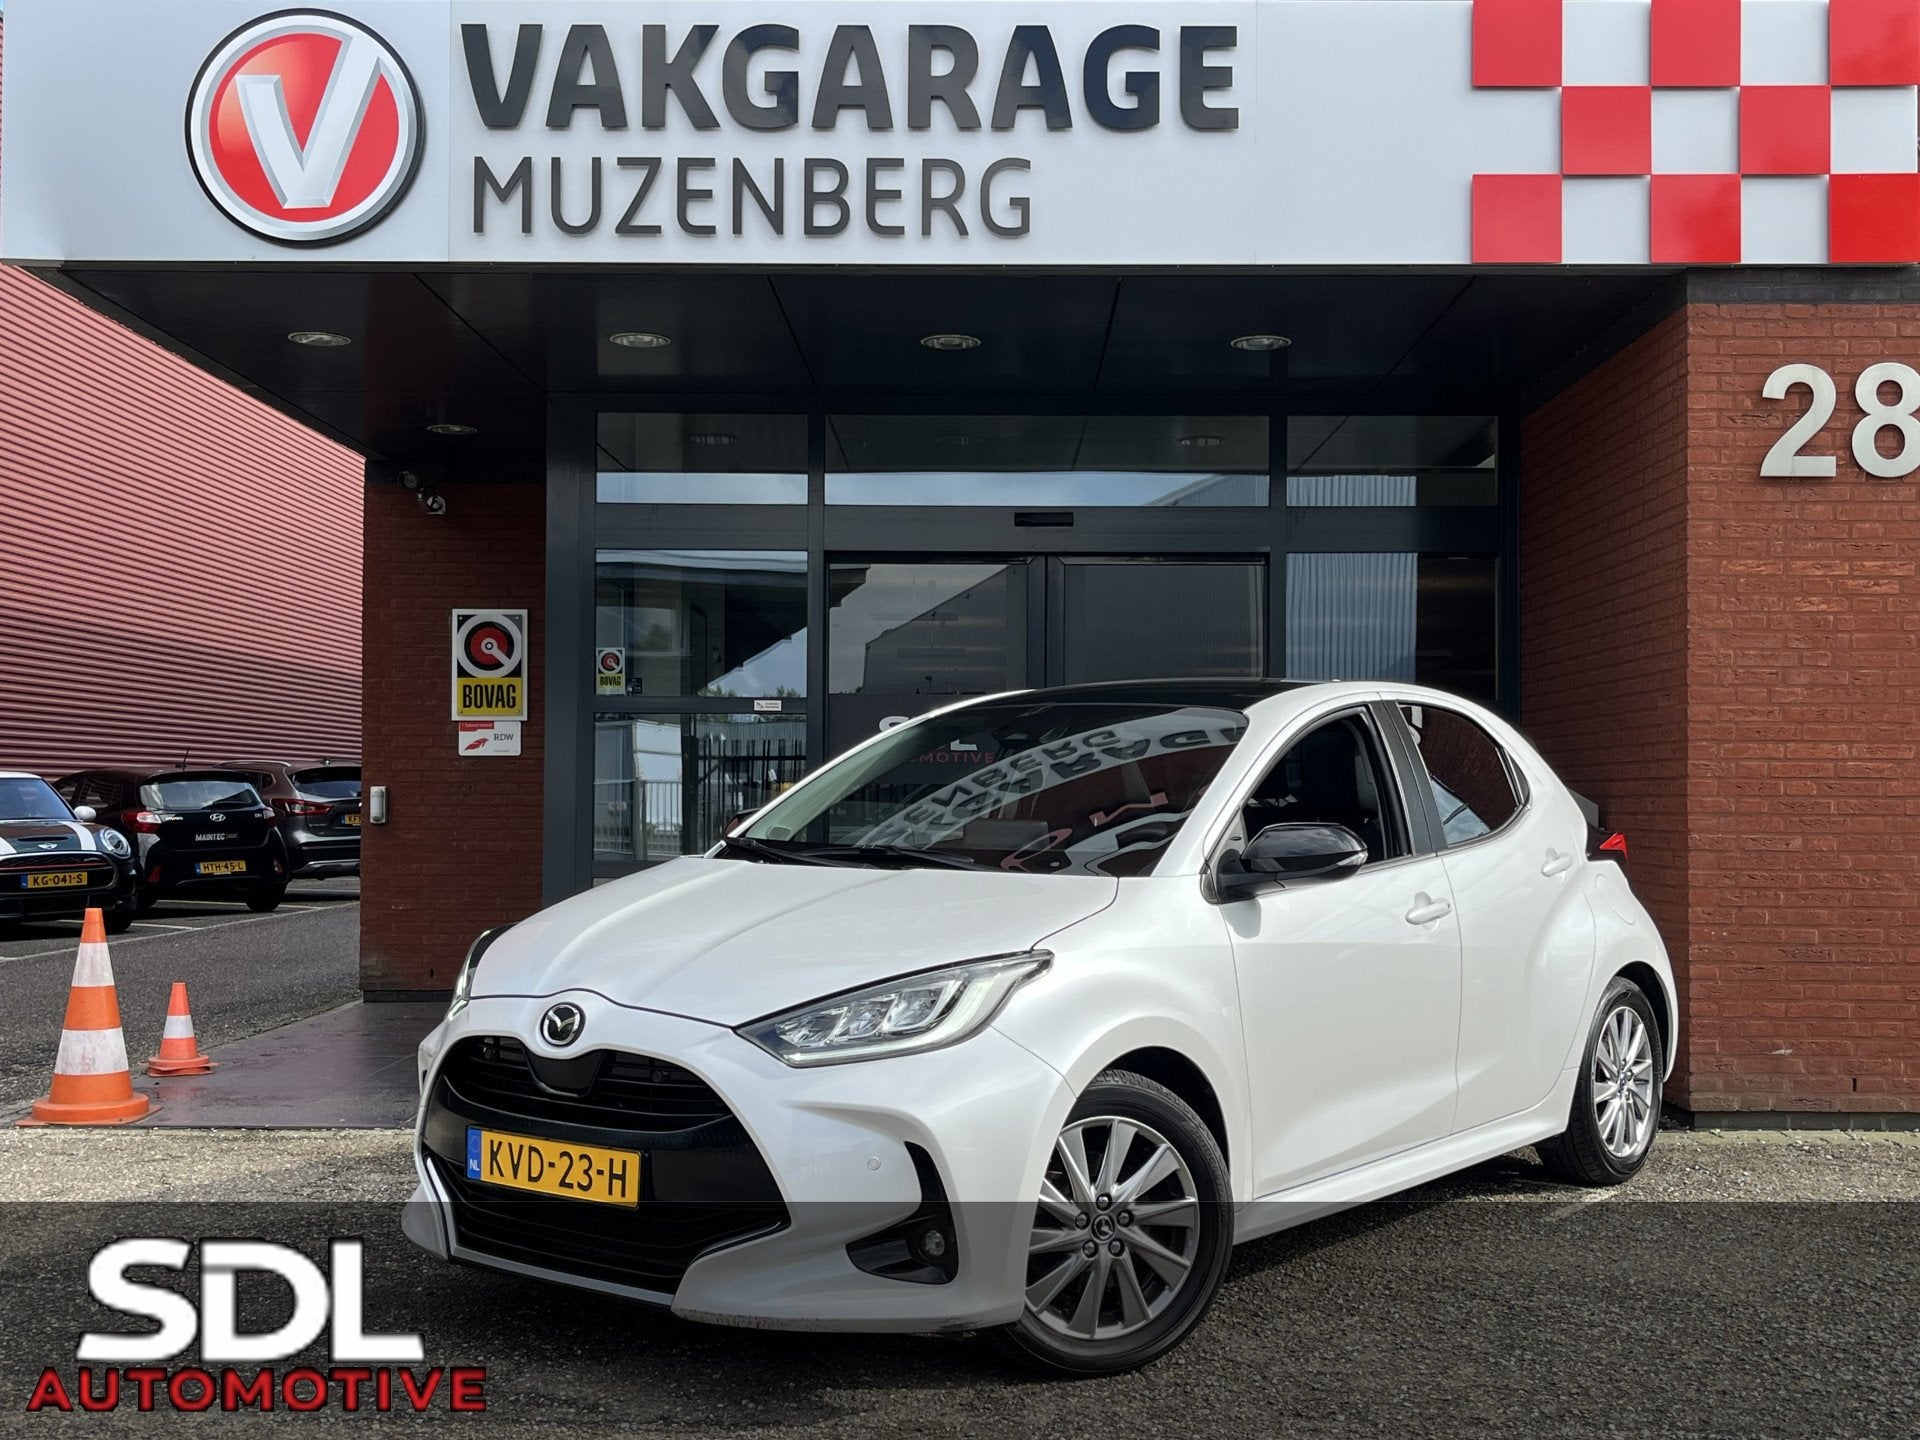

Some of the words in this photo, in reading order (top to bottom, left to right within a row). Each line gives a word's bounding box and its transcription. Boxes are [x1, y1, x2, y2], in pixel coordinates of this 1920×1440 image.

[460, 23, 1240, 134] VAKGARAGE
[235, 34, 382, 210] V
[473, 156, 1032, 239] MUZENBERG
[1760, 362, 1920, 478] 28
[600, 676, 622, 686] BOVAG
[462, 684, 517, 709] BOVAG
[493, 733, 514, 741] RDW
[920, 752, 996, 764] MOTIVE
[203, 863, 244, 872] HTH-45-L
[33, 874, 83, 886] KG-041-S
[469, 1158, 481, 1171] NL
[489, 1139, 627, 1198] KVD-23-H
